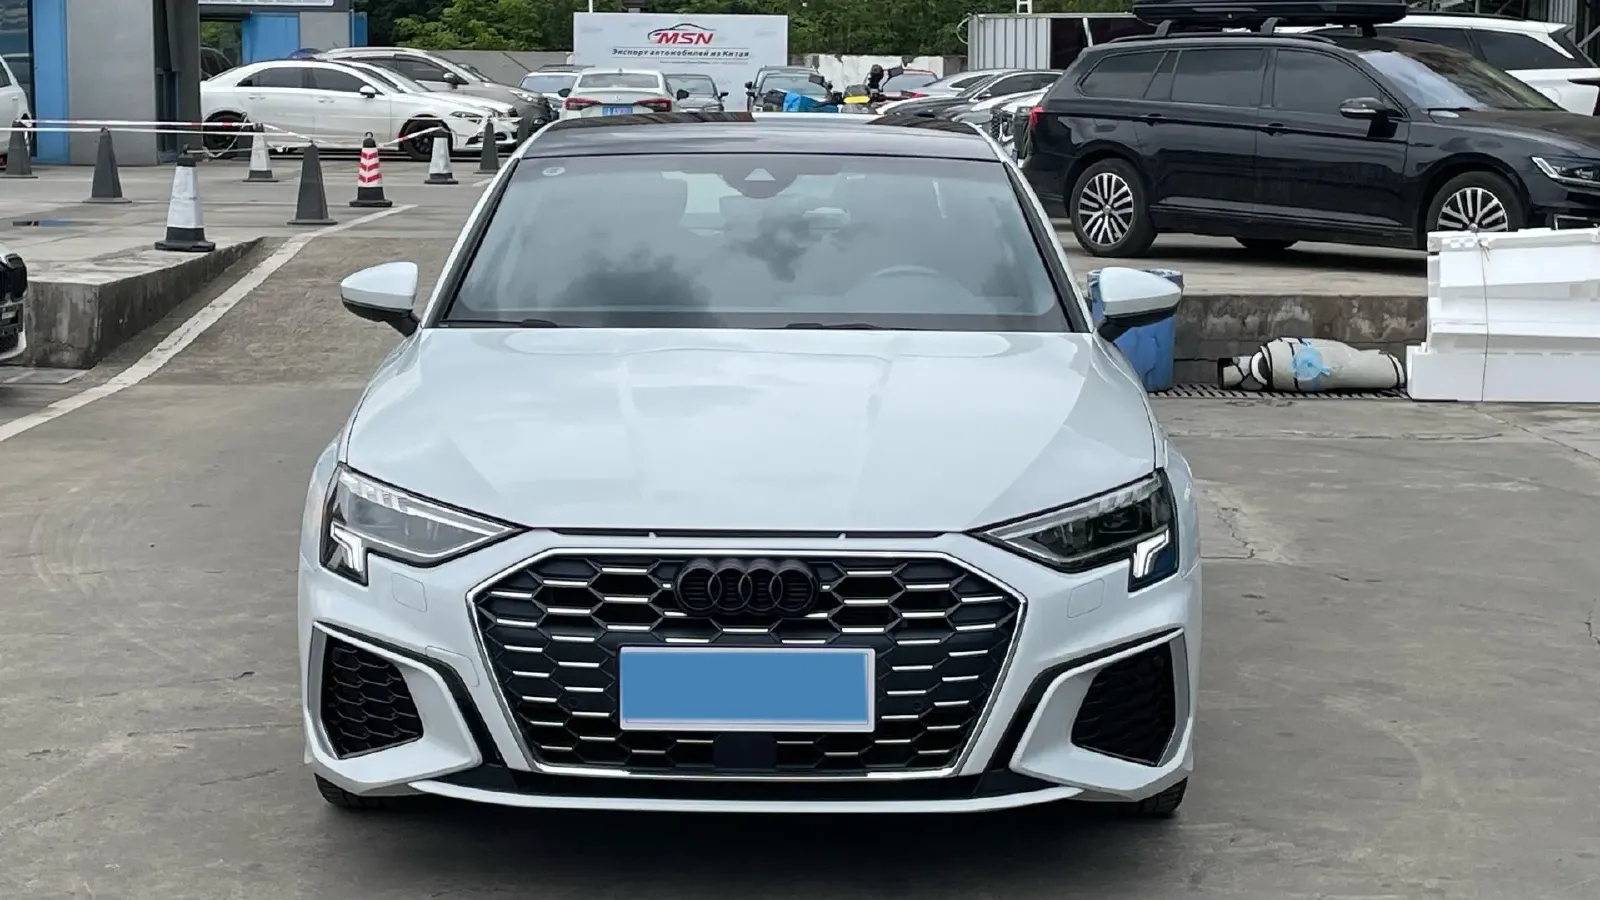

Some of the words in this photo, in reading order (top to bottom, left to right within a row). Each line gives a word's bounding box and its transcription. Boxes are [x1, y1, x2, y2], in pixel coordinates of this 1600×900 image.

[657, 32, 714, 44] MSN
[612, 48, 648, 56] Экспорт
[649, 49, 709, 57] автомобилей
